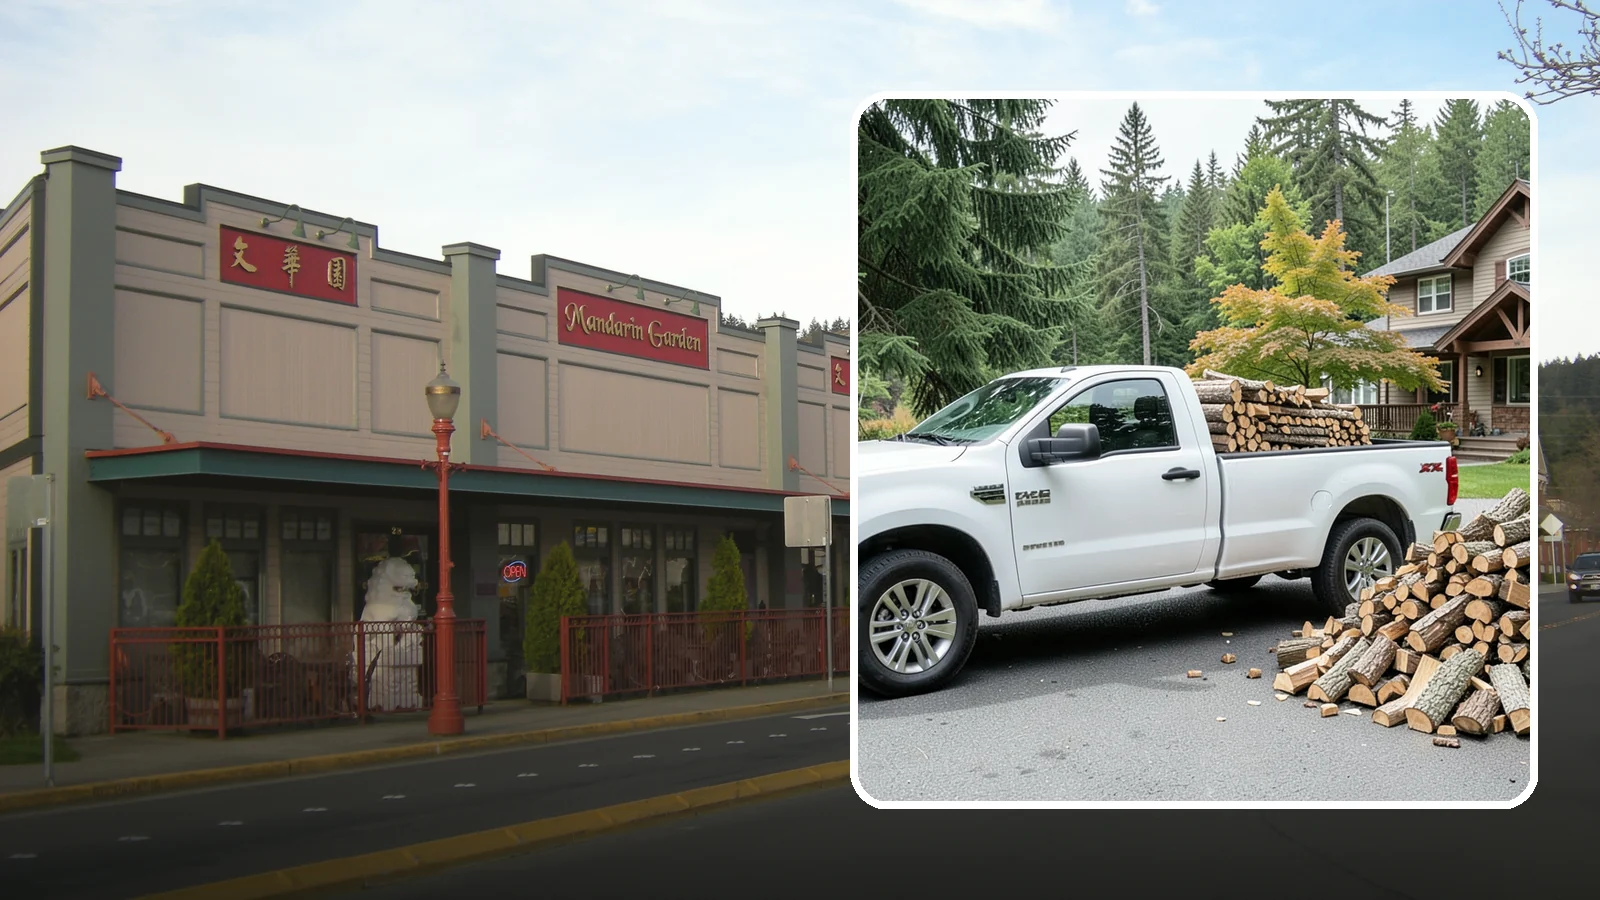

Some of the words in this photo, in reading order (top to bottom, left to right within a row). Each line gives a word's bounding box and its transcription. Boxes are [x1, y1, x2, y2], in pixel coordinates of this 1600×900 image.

[230, 235, 346, 291] 文華園
[564, 302, 644, 341] Mandarin
[647, 320, 702, 352] Garden
[834, 363, 846, 386] 文
[503, 565, 527, 578] OPEN
